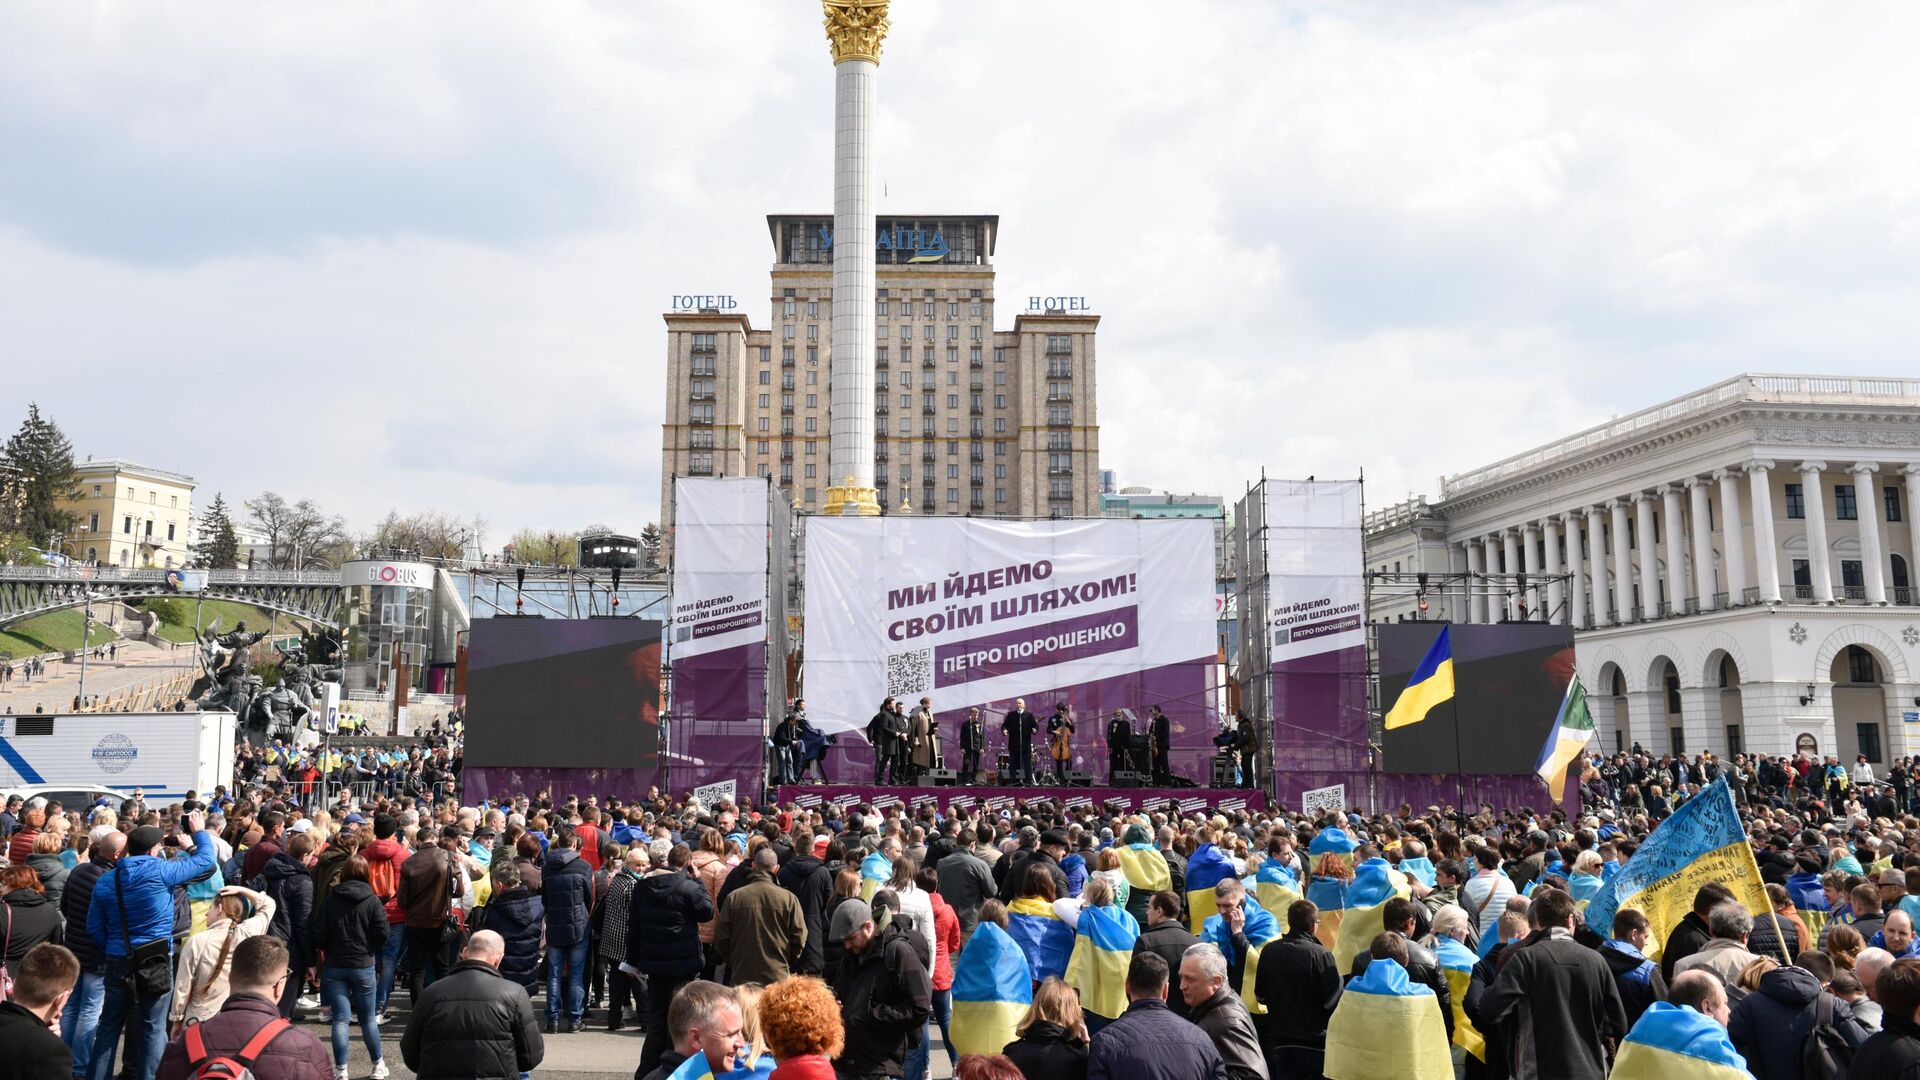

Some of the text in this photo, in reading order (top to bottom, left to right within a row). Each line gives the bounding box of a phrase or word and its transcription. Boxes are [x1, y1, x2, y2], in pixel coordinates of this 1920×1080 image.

[818, 225, 947, 250] УАЇНА
[672, 295, 737, 309] ГОТЕЛЬ
[1028, 296, 1091, 310] HOTEL
[368, 566, 417, 584] GLOBUS
[888, 559, 1053, 610] МИ ЙДЕМО
[676, 599, 762, 624] СВОЇМ ШЛЯХОМ!
[677, 595, 734, 613] МИ ЙДЕМО
[888, 573, 1137, 641] СВОЇМ ШЛЯХОМ!
[1274, 598, 1331, 616] МИ ЙДЕМО
[1274, 603, 1360, 627] СВОЇМ ШЛЯХОМ!
[695, 616, 759, 635] ПЕТРО ПОРОШЕНКО
[1293, 619, 1357, 638] ПЕТРО ПОРОШЕНКО
[943, 622, 1126, 674] ПЕТРО ПОРОШЕНКО
